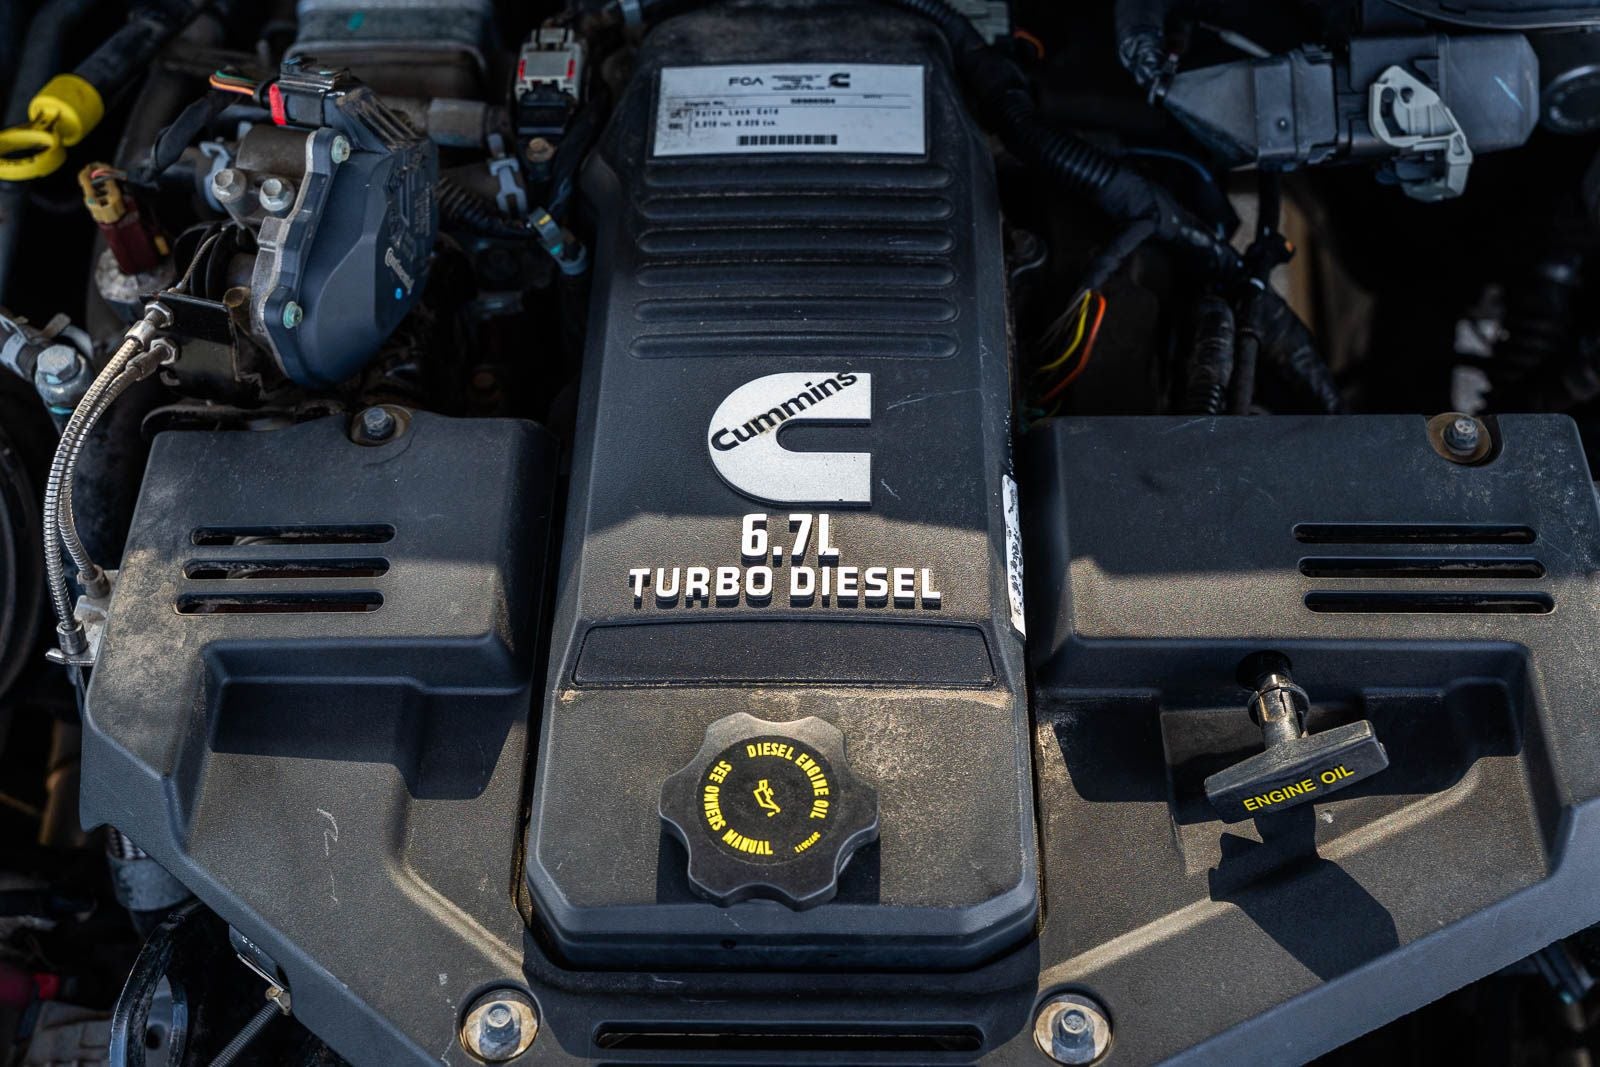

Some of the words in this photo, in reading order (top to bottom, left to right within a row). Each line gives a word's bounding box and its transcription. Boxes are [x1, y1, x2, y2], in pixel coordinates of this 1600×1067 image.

[728, 77, 764, 87] FCA
[711, 373, 857, 451] Cummins
[741, 513, 840, 560] 6.7L
[629, 566, 773, 599] TURBO
[790, 566, 941, 600] DIESEL
[746, 742, 795, 761] DIESEL
[708, 760, 733, 784] SEE
[794, 752, 830, 797] ENGINE
[1243, 778, 1317, 811] ENGINE
[1320, 765, 1355, 784] OIL
[703, 785, 727, 831] OWNERS
[809, 799, 830, 819] OIL
[721, 828, 773, 855] MANUAL
